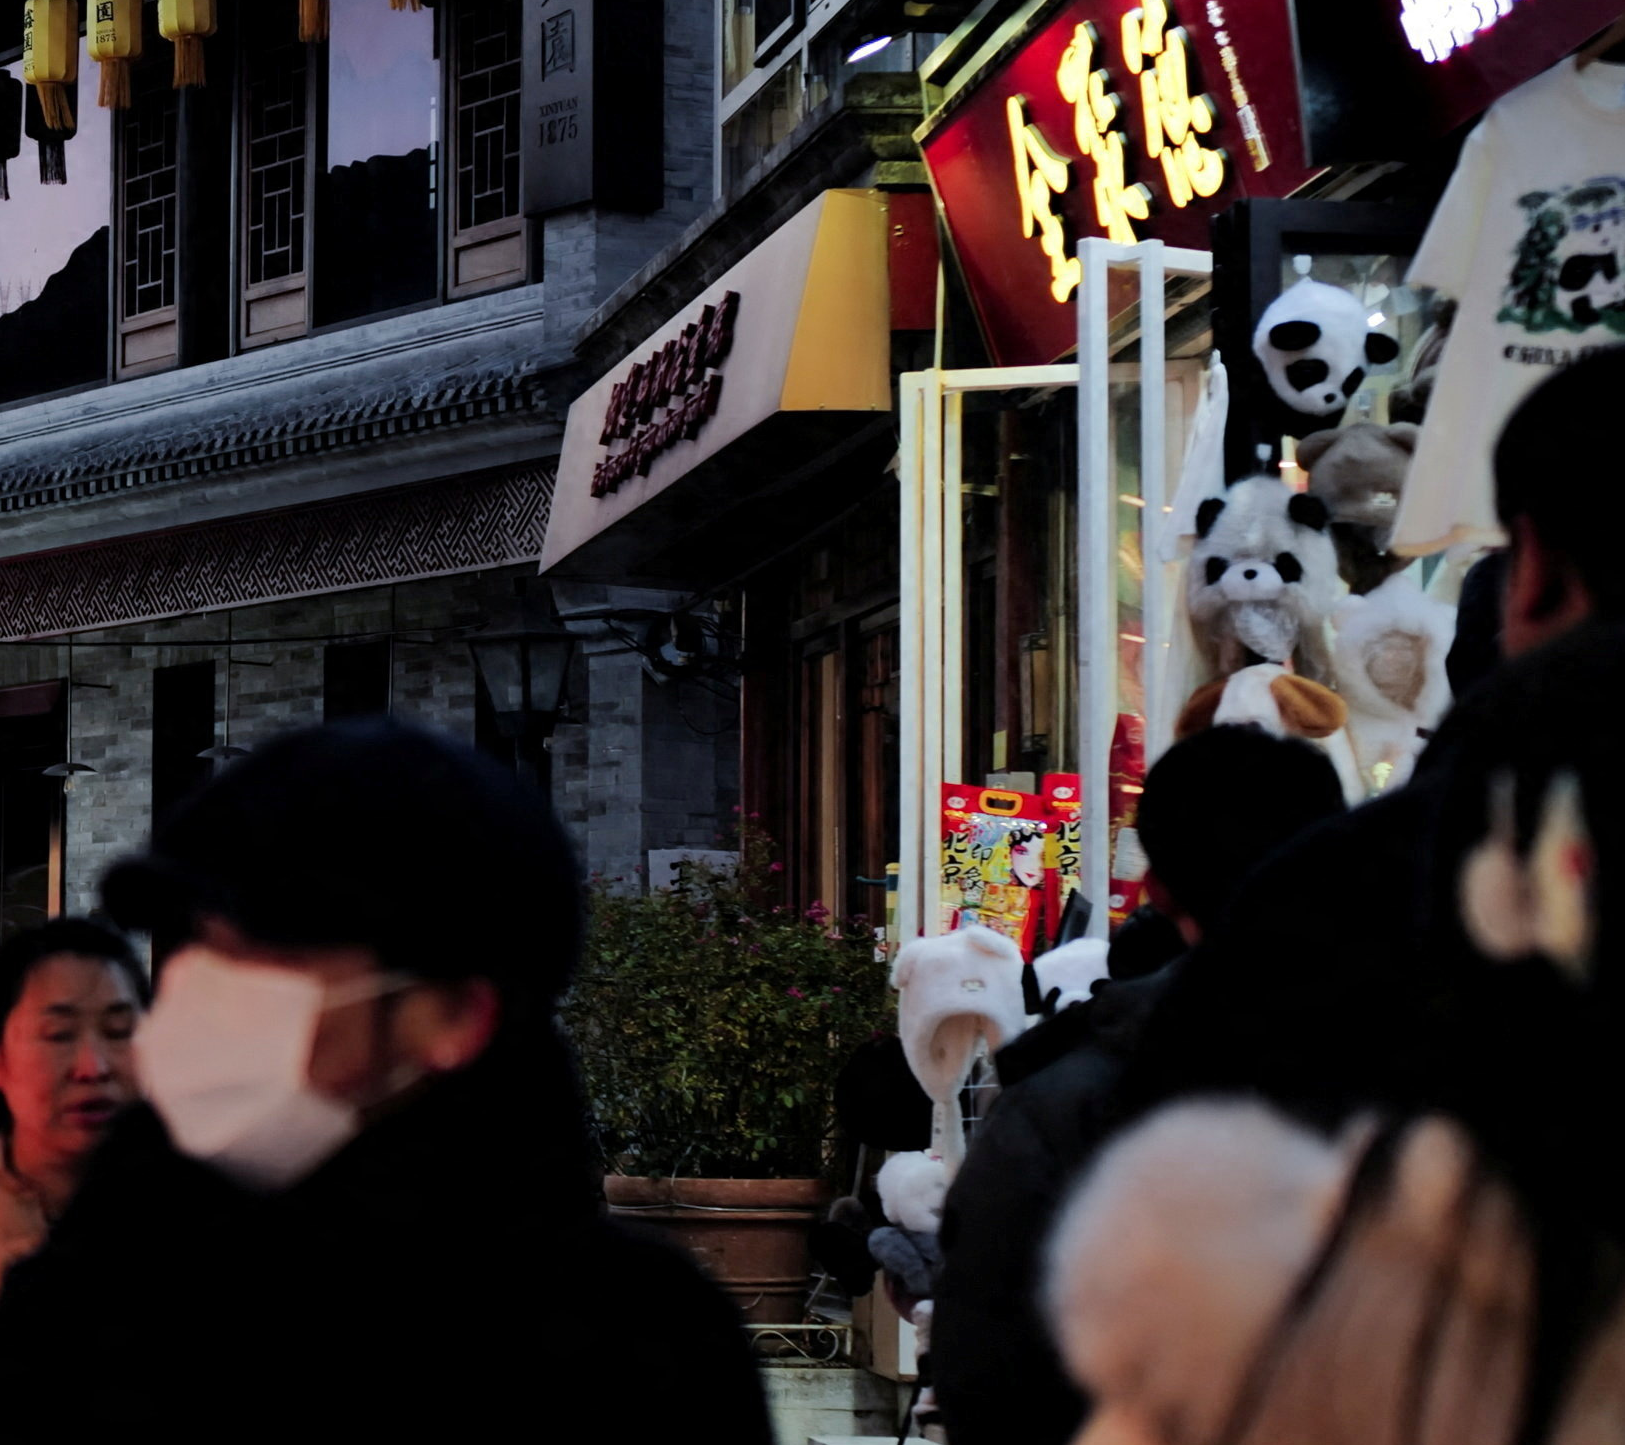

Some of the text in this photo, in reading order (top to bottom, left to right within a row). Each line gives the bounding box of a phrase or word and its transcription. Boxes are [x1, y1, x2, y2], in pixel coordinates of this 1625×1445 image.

[539, 95, 579, 117] XINYUAN
[538, 114, 579, 148] 1875
[942, 830, 970, 885] 北京
